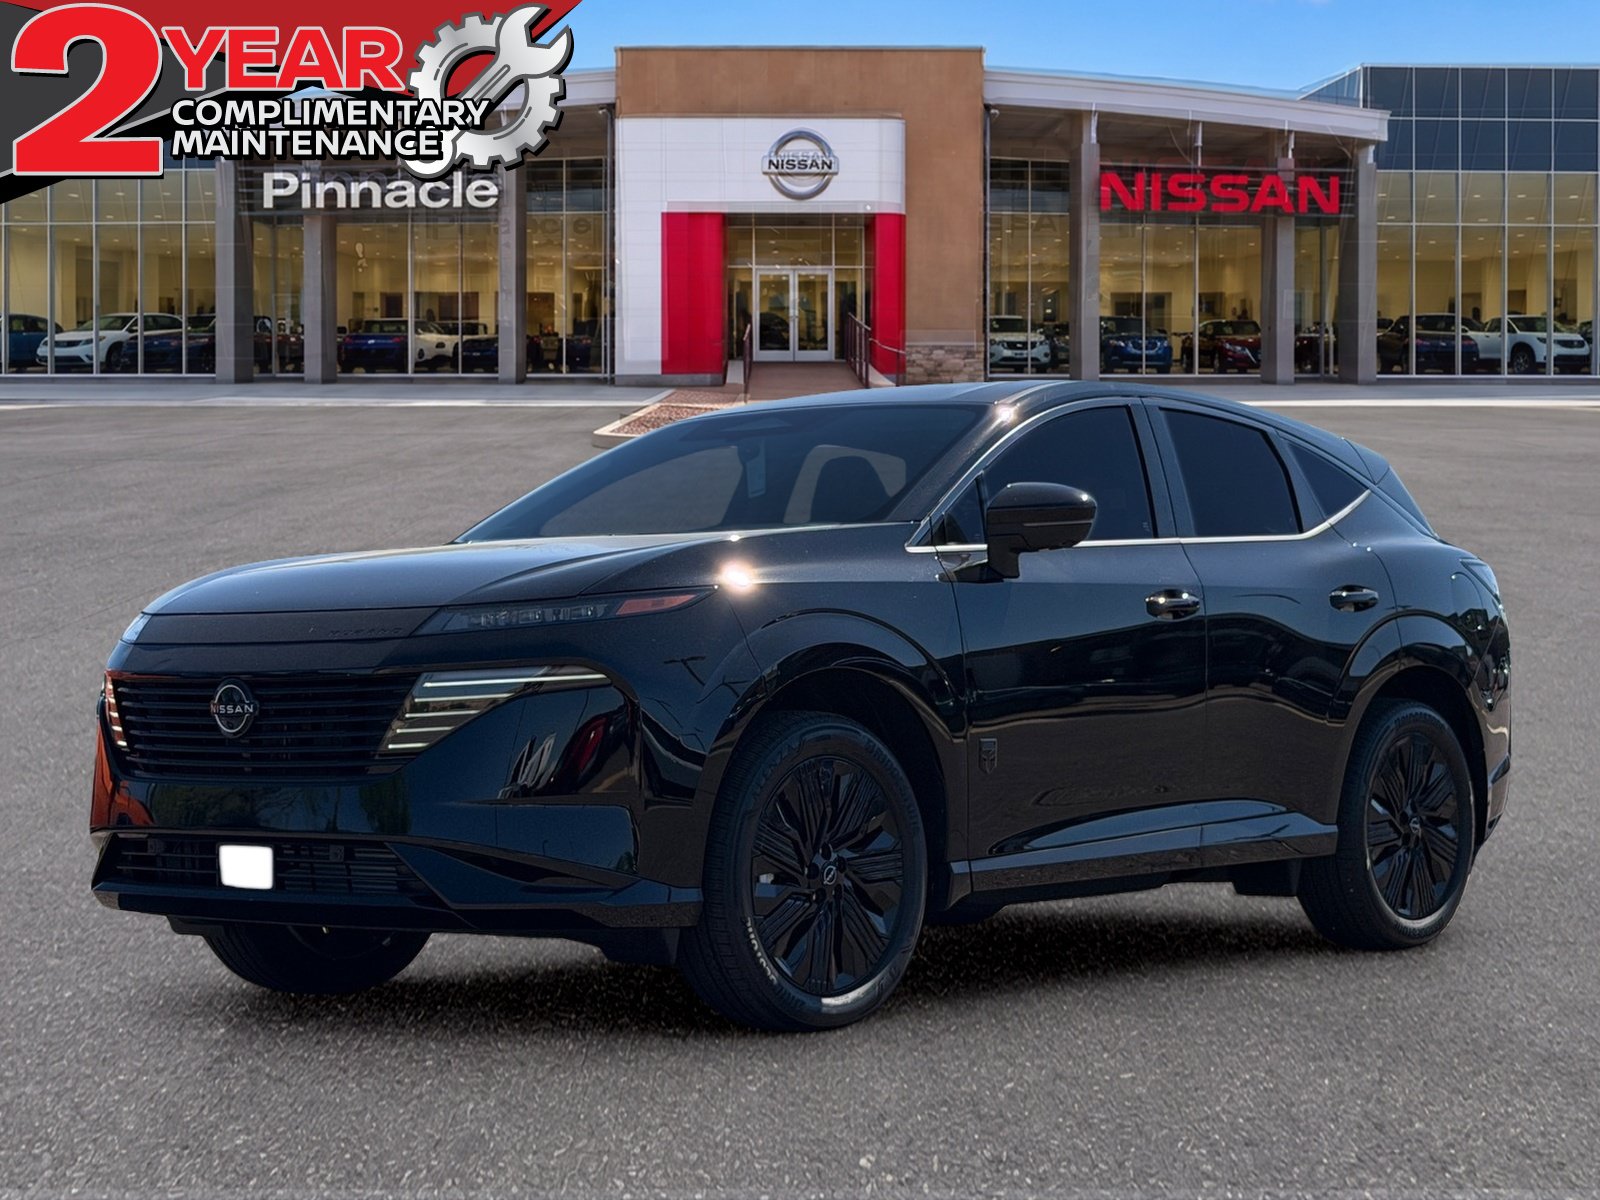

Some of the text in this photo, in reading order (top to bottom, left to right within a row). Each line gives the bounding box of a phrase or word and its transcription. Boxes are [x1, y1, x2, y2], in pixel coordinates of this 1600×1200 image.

[767, 158, 833, 171] NISSAN
[263, 171, 500, 209] Pinnacle
[1100, 172, 1341, 214] NISSAN
[210, 703, 255, 715] NISSAN
